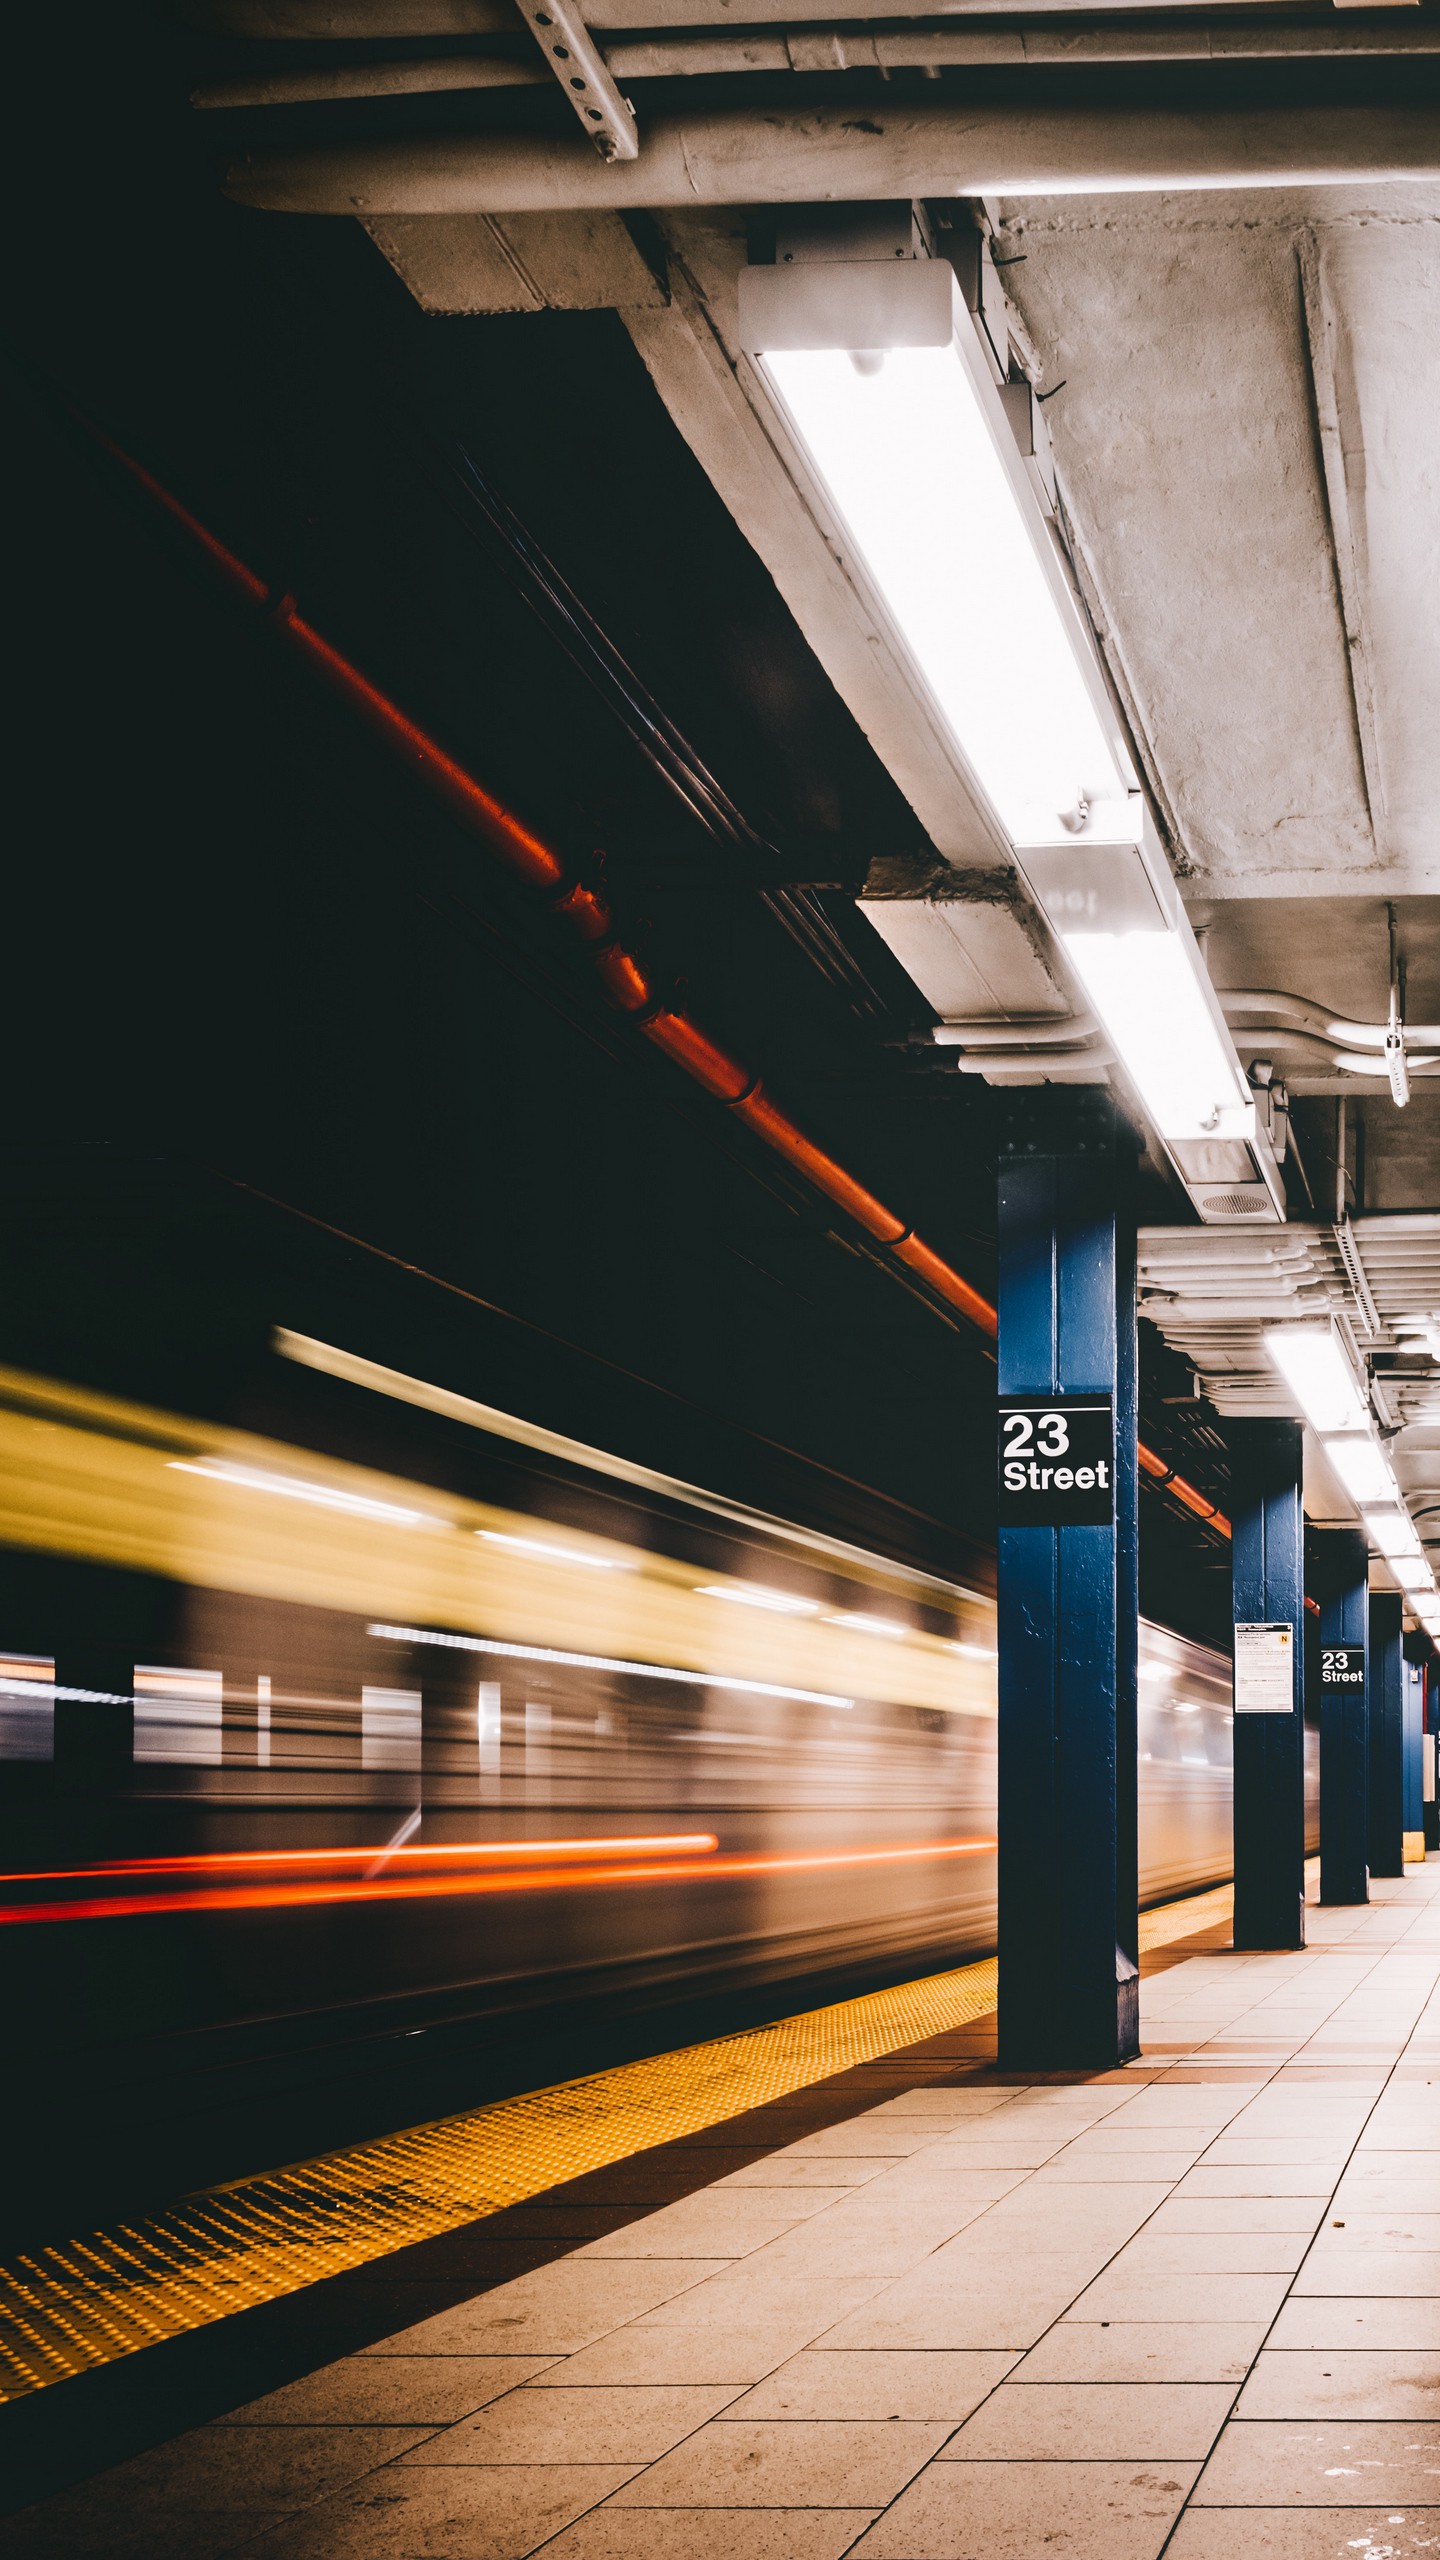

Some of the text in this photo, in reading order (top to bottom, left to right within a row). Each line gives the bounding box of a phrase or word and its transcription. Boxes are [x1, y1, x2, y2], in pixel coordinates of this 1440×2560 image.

[1003, 1413, 1070, 1458] 23
[1003, 1460, 1109, 1491] Street
[1322, 1652, 1349, 1670] 23
[1322, 1670, 1364, 1682] Street
